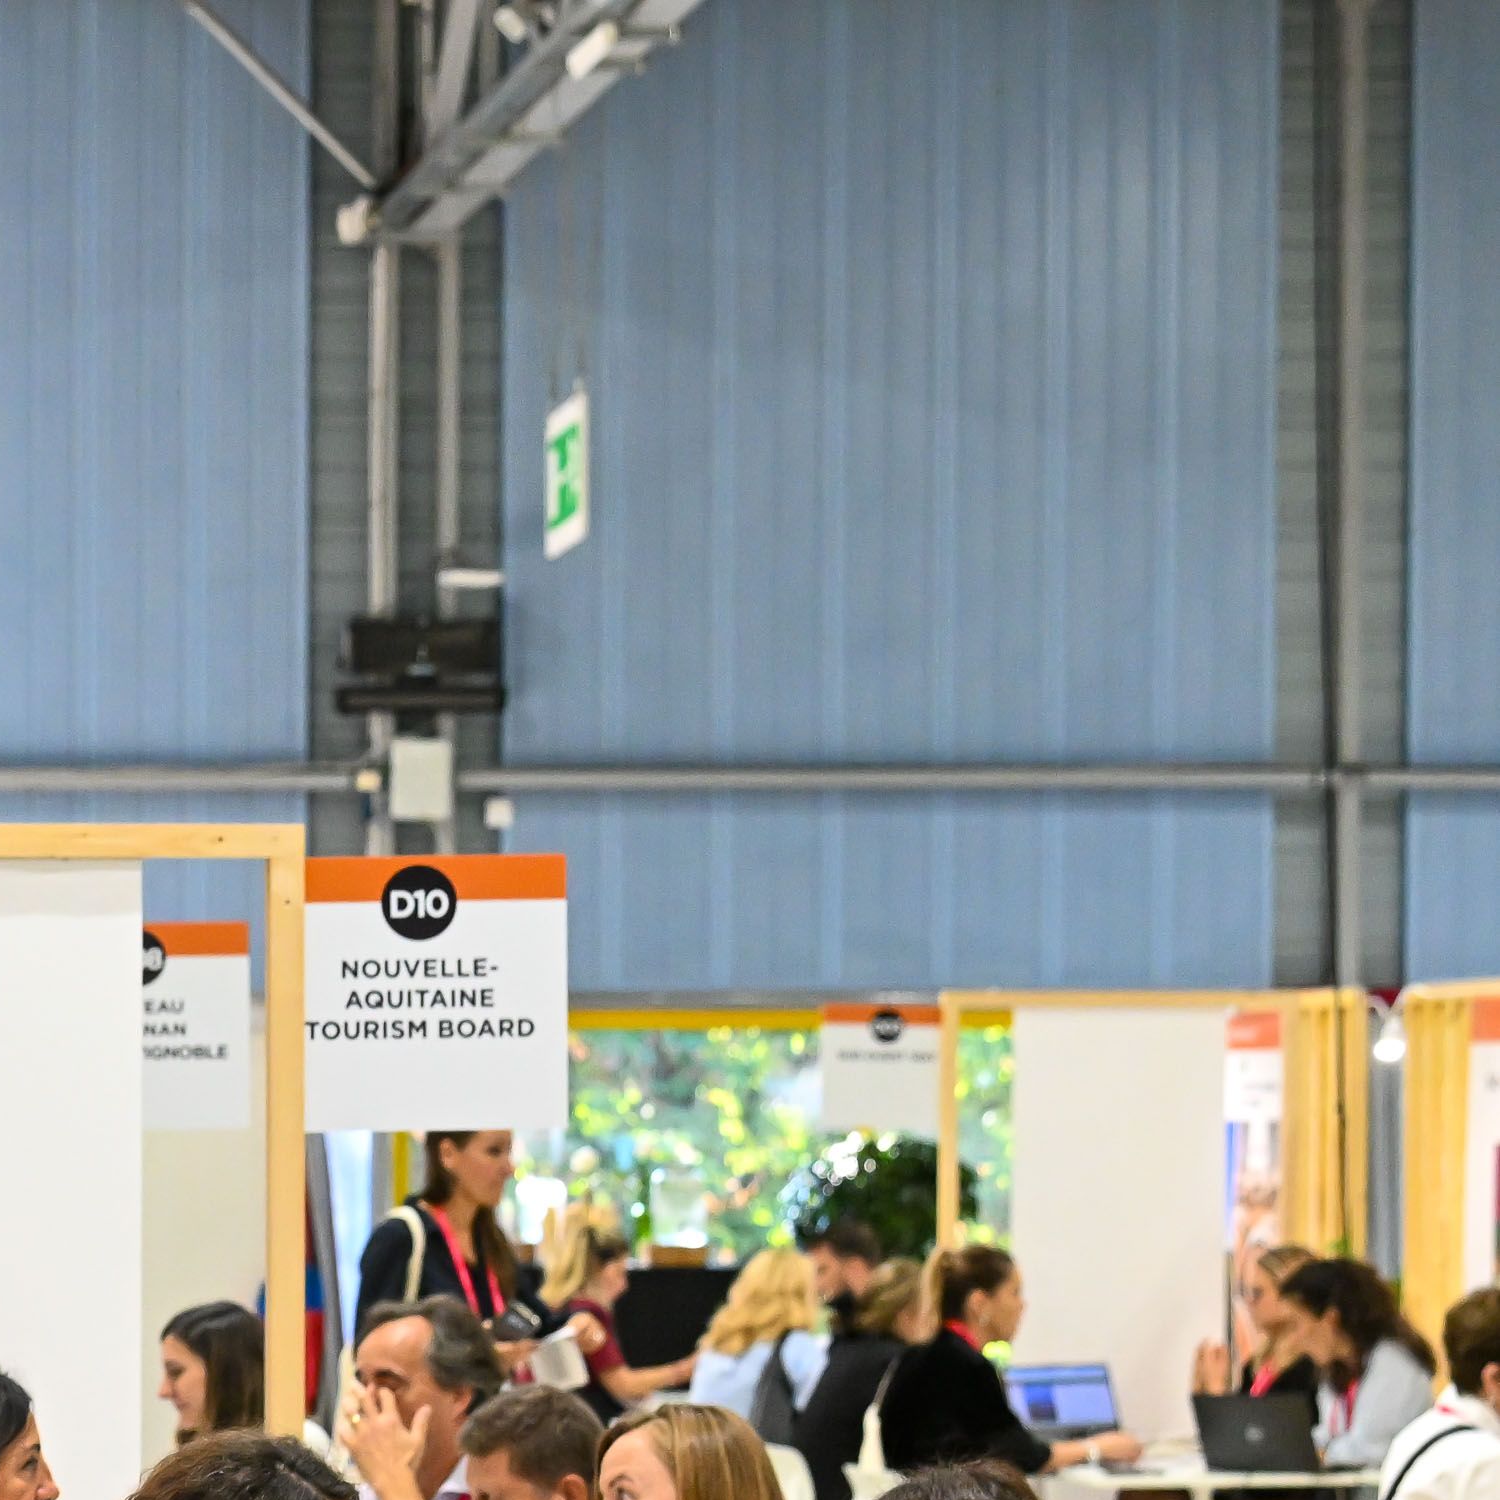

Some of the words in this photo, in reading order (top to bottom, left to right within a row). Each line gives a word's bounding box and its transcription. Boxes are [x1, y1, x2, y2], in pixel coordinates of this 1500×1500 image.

[388, 888, 451, 919] D10
[341, 957, 499, 979] NOUVELLE-
[345, 988, 494, 1011] AQUITAINE
[305, 1020, 427, 1041] TOURISM
[438, 1019, 536, 1039] BOARD
